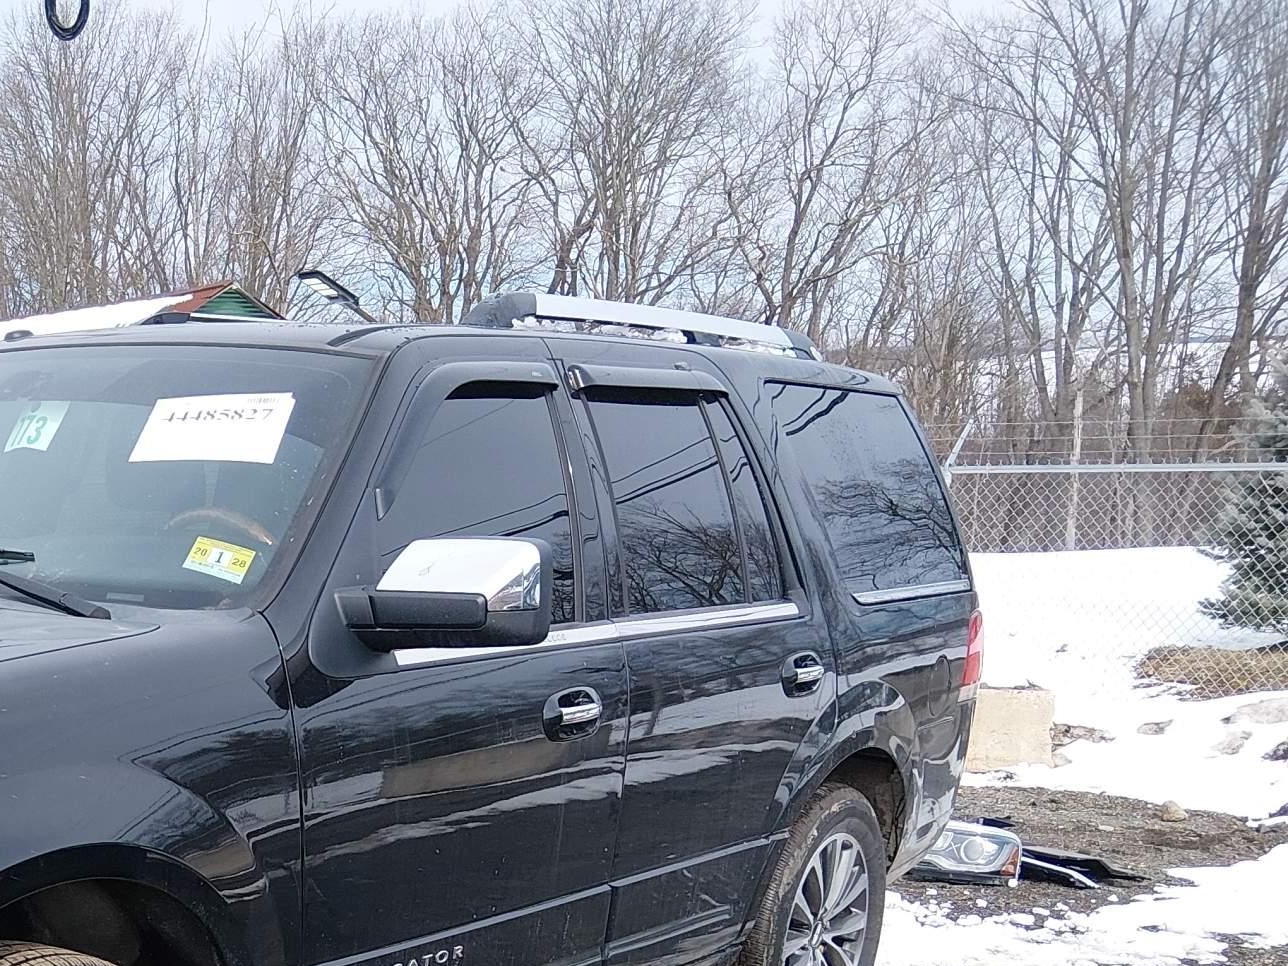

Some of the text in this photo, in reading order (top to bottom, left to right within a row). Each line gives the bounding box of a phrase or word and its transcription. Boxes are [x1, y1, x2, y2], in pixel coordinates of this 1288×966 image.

[160, 408, 274, 423] 44485827
[193, 546, 247, 568] 20 1 28
